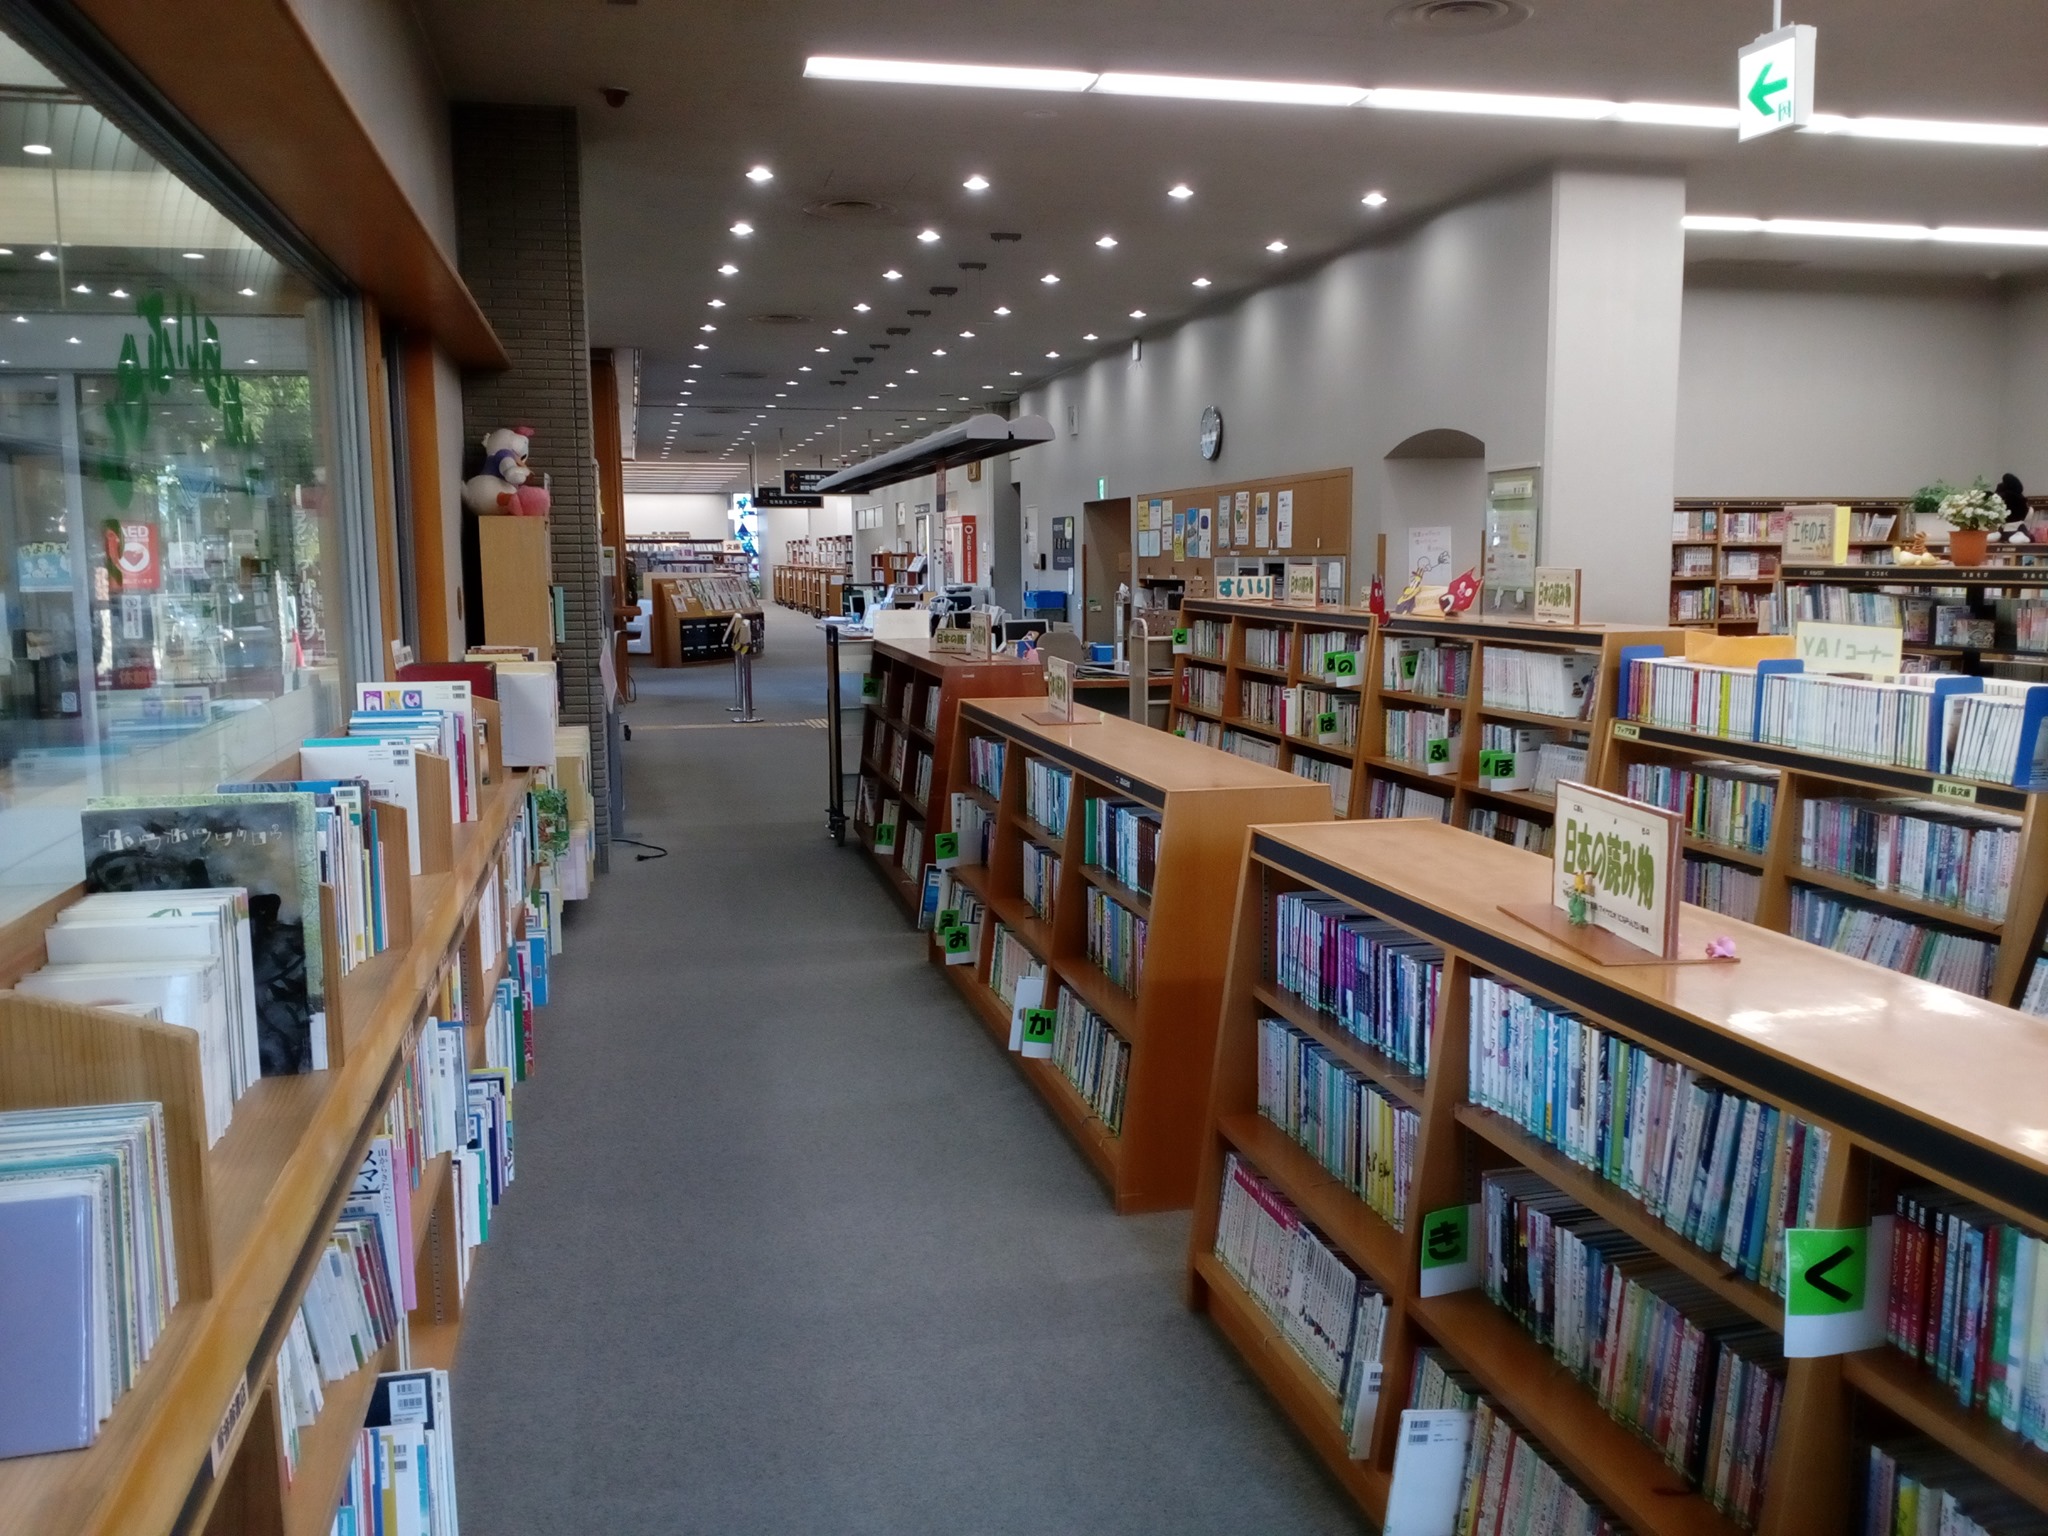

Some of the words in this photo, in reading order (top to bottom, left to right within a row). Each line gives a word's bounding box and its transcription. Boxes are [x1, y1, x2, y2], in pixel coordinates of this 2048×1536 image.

[1792, 520, 1827, 544] 工作の本
[1174, 631, 1187, 645] と
[1337, 660, 1353, 674] の
[1320, 717, 1335, 733] は
[1430, 744, 1447, 762] ふ
[1494, 758, 1515, 777] ほ
[1937, 783, 1971, 798] 青い鳥文庫
[939, 837, 956, 854] う
[1563, 818, 1655, 911] 日本の読み物
[949, 930, 968, 949] お
[1028, 1012, 1052, 1037] か
[1427, 1220, 1462, 1261] き
[1804, 1244, 1856, 1304] く
